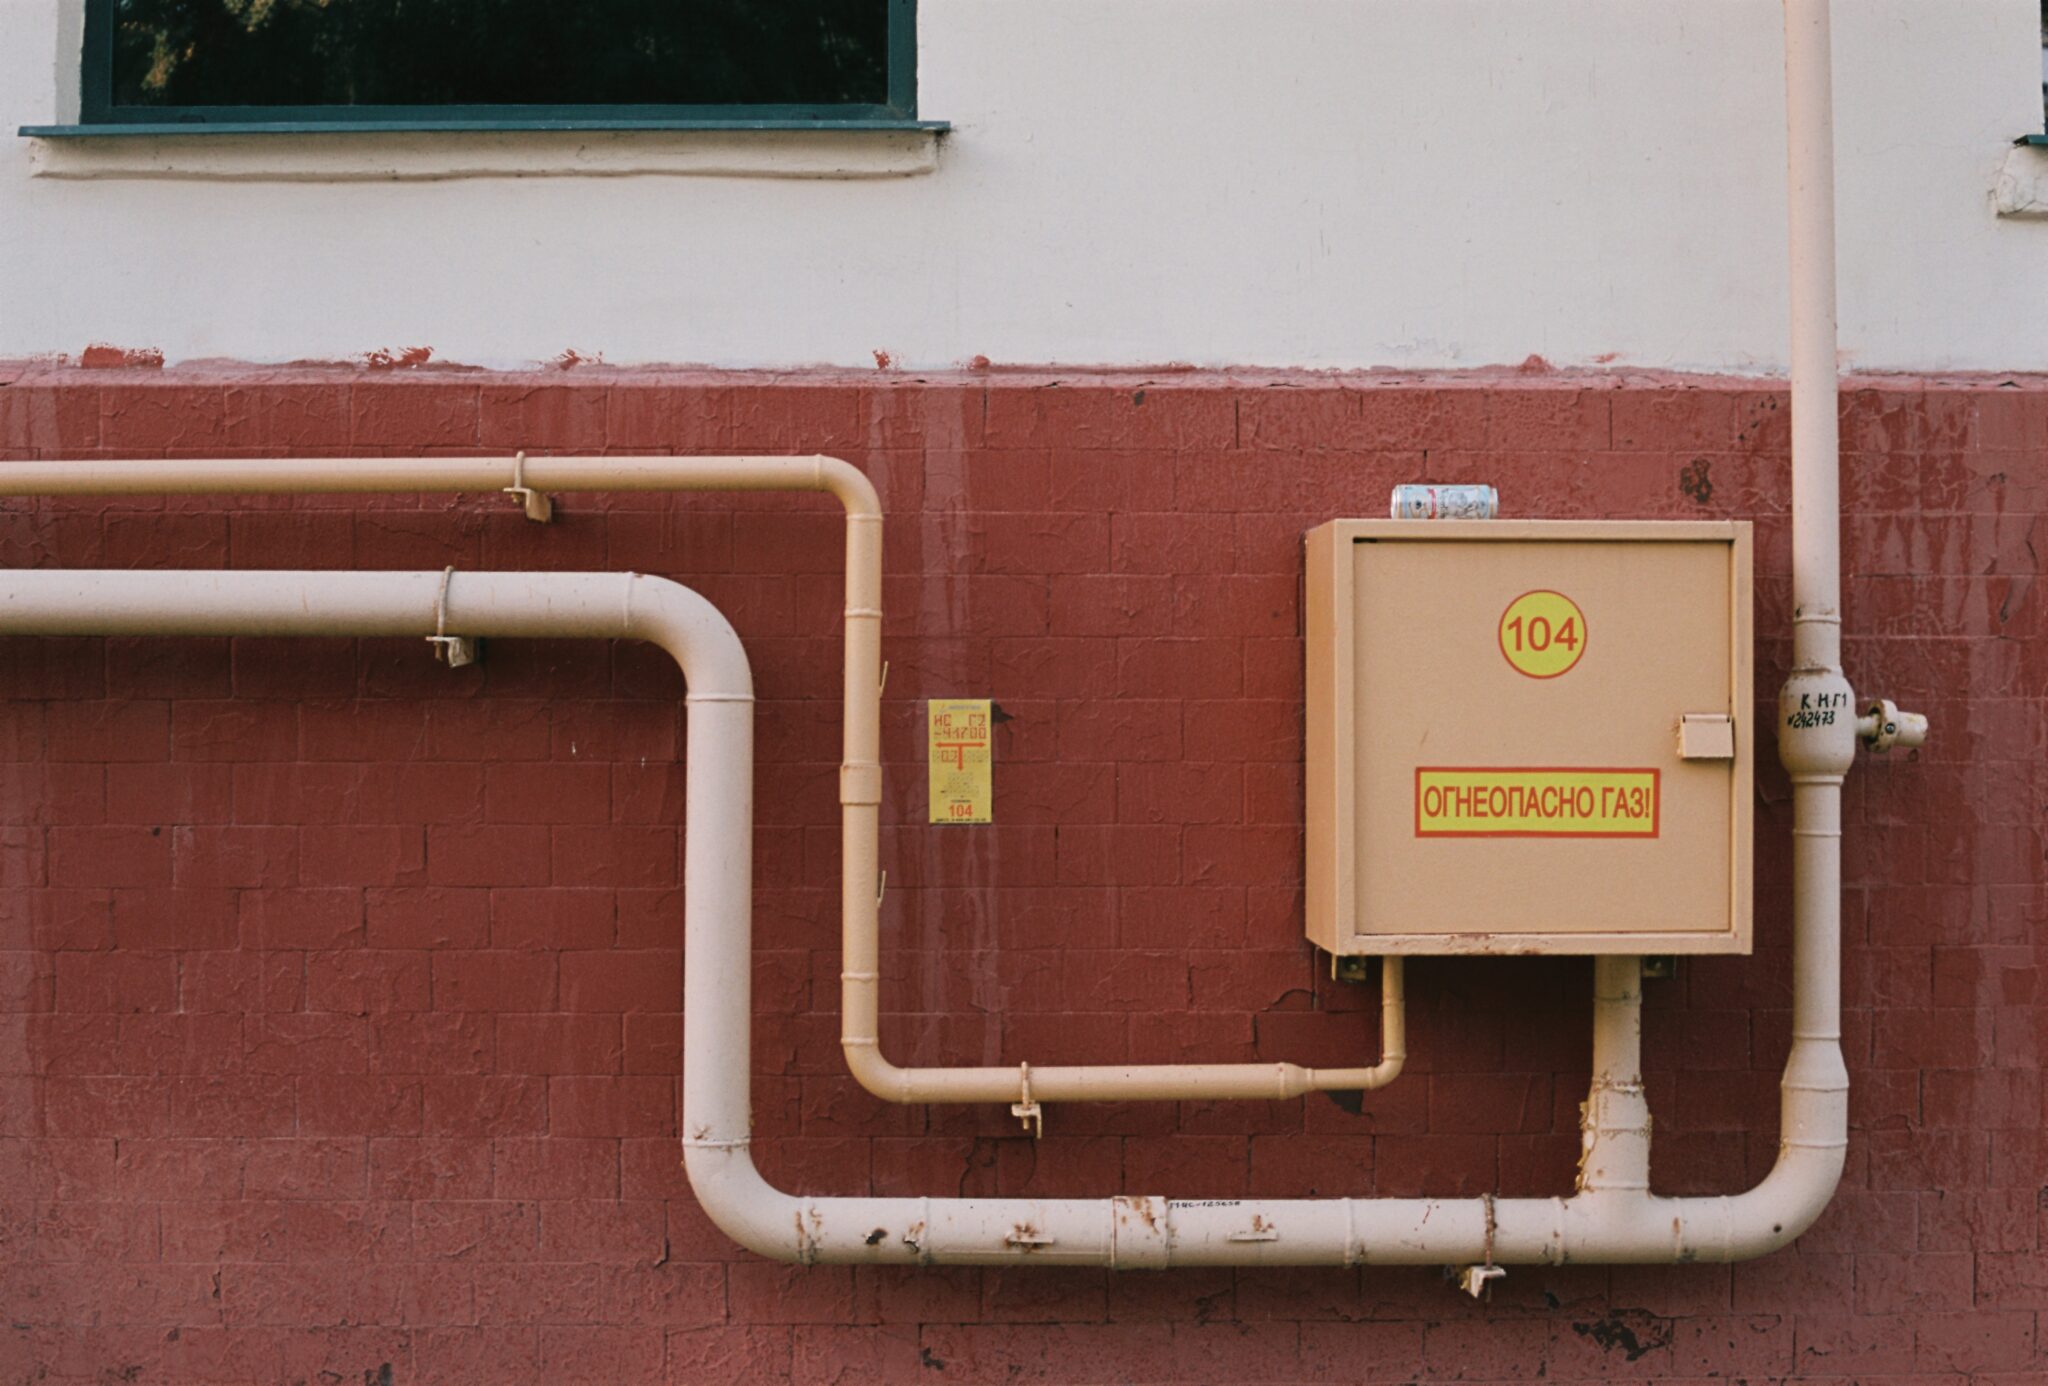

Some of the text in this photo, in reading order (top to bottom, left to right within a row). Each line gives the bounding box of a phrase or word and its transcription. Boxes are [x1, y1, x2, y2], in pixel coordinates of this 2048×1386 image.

[1507, 615, 1578, 651] 104
[948, 803, 974, 817] 104
[1423, 785, 1651, 818] ОГНЕОПАСНО ГАЗ!
